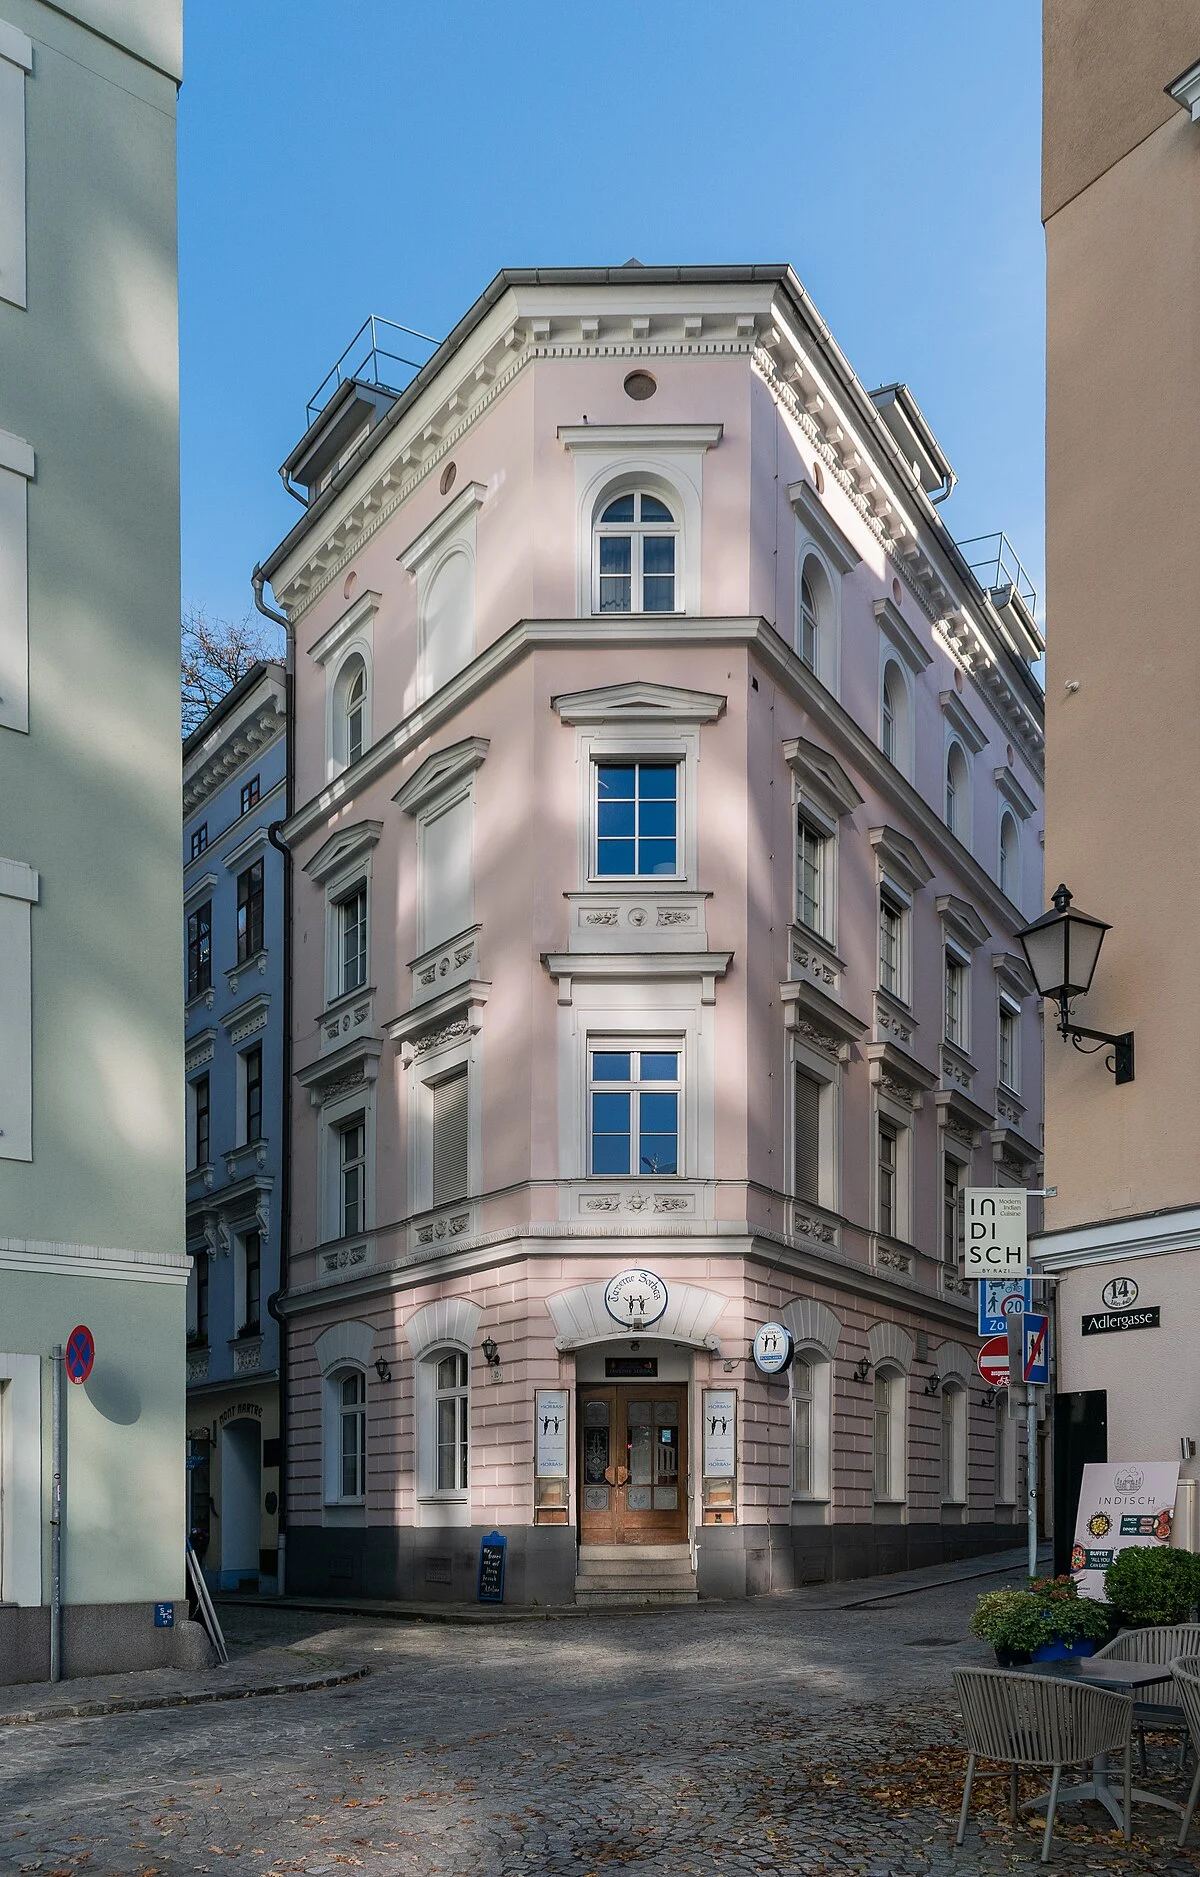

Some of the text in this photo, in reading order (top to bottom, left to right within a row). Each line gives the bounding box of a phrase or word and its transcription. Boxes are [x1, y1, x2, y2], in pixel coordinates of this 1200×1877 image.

[971, 1222, 995, 1239] DI
[970, 1246, 1021, 1263] SCH
[1111, 1280, 1129, 1299] 14
[1007, 1301, 1022, 1314] 20
[1088, 1313, 1153, 1330] Adlergasse
[219, 1403, 263, 1425] MONT MARTRE
[1098, 1496, 1156, 1505] INDISCH
